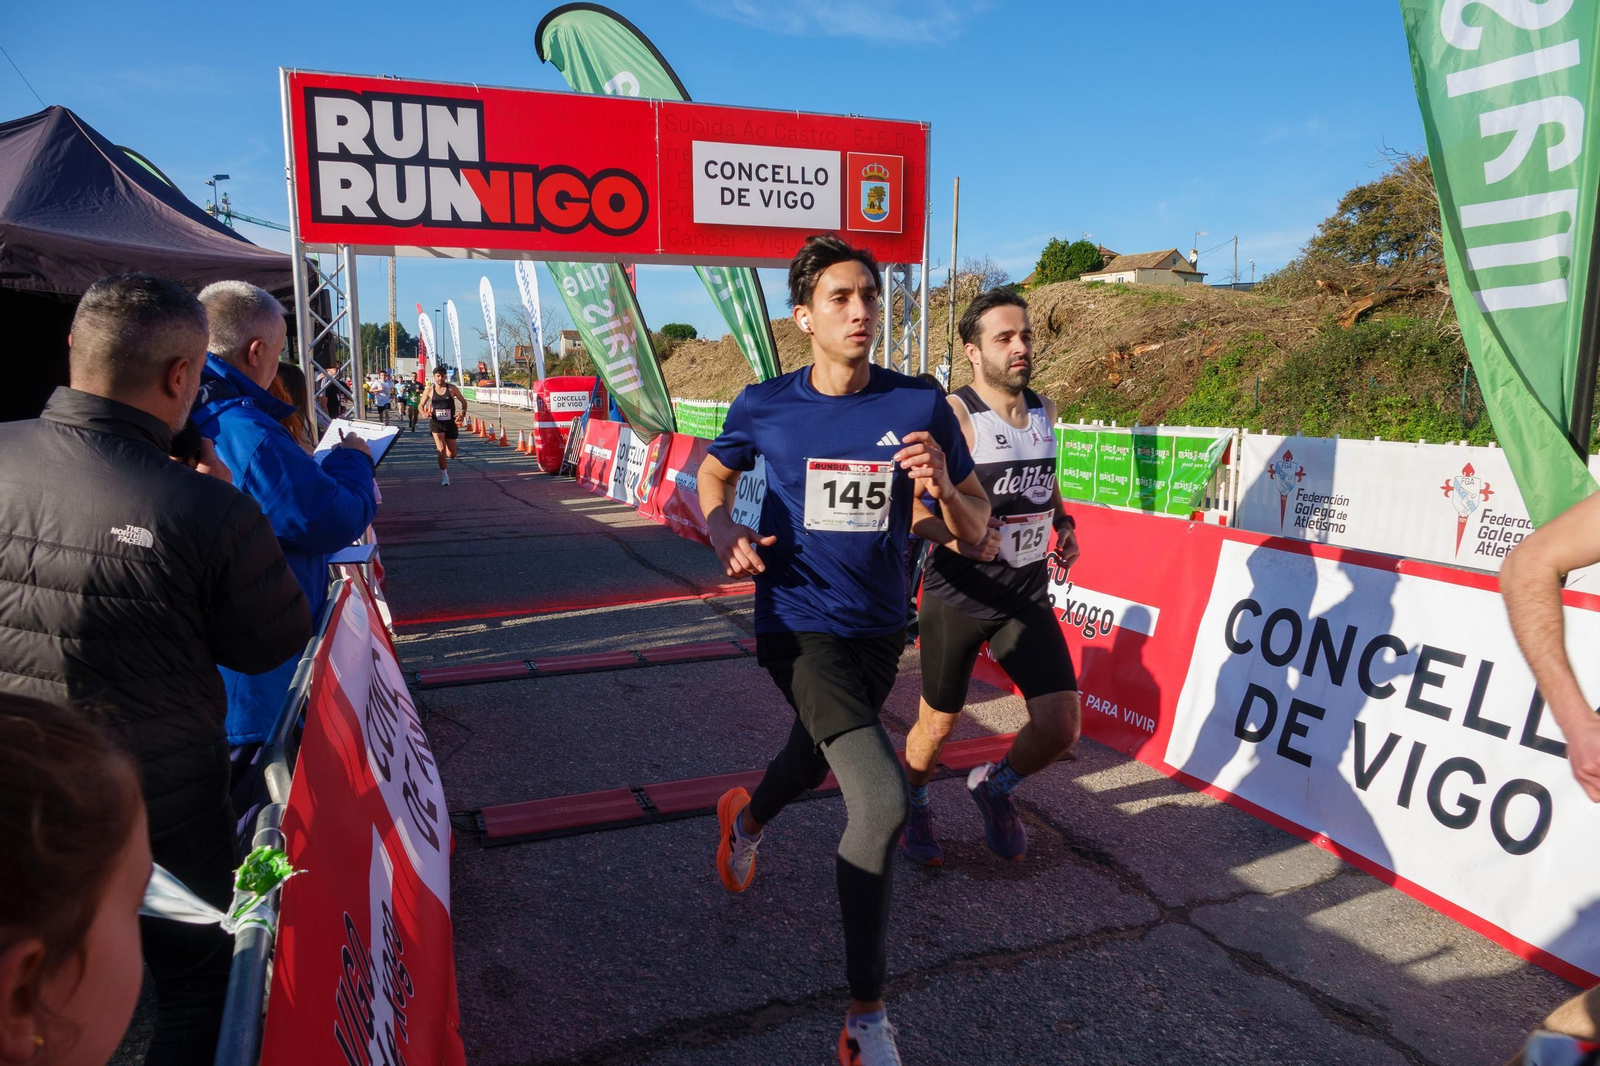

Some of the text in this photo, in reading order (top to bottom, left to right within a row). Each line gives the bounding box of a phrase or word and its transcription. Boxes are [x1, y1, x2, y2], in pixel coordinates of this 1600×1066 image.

[314, 96, 479, 162] RUN
[665, 113, 736, 138] Subida
[743, 121, 768, 139] Ao
[774, 122, 837, 145] Castro
[854, 128, 888, 148] 5+5
[704, 160, 829, 186] CONCELLO
[720, 187, 815, 211] DE VIGO
[667, 227, 738, 248] Cáncer
[993, 465, 1056, 495] delikia
[1460, 477, 1474, 486] FGA
[823, 480, 886, 510] 145
[1032, 489, 1047, 498] fresh
[1296, 488, 1350, 506] Federación
[1294, 502, 1348, 520] Galega de
[1480, 508, 1534, 530] Federac
[110, 527, 140, 539] NORTH
[126, 524, 142, 534] THE
[1294, 516, 1346, 534] Atletismo
[118, 536, 140, 546] FACE
[1011, 526, 1045, 552] 125
[1060, 598, 1115, 639] xogo
[1224, 598, 1569, 760] CONCELL
[1086, 693, 1155, 734] PARA VIVIR
[1234, 682, 1553, 855] DE VIGO
